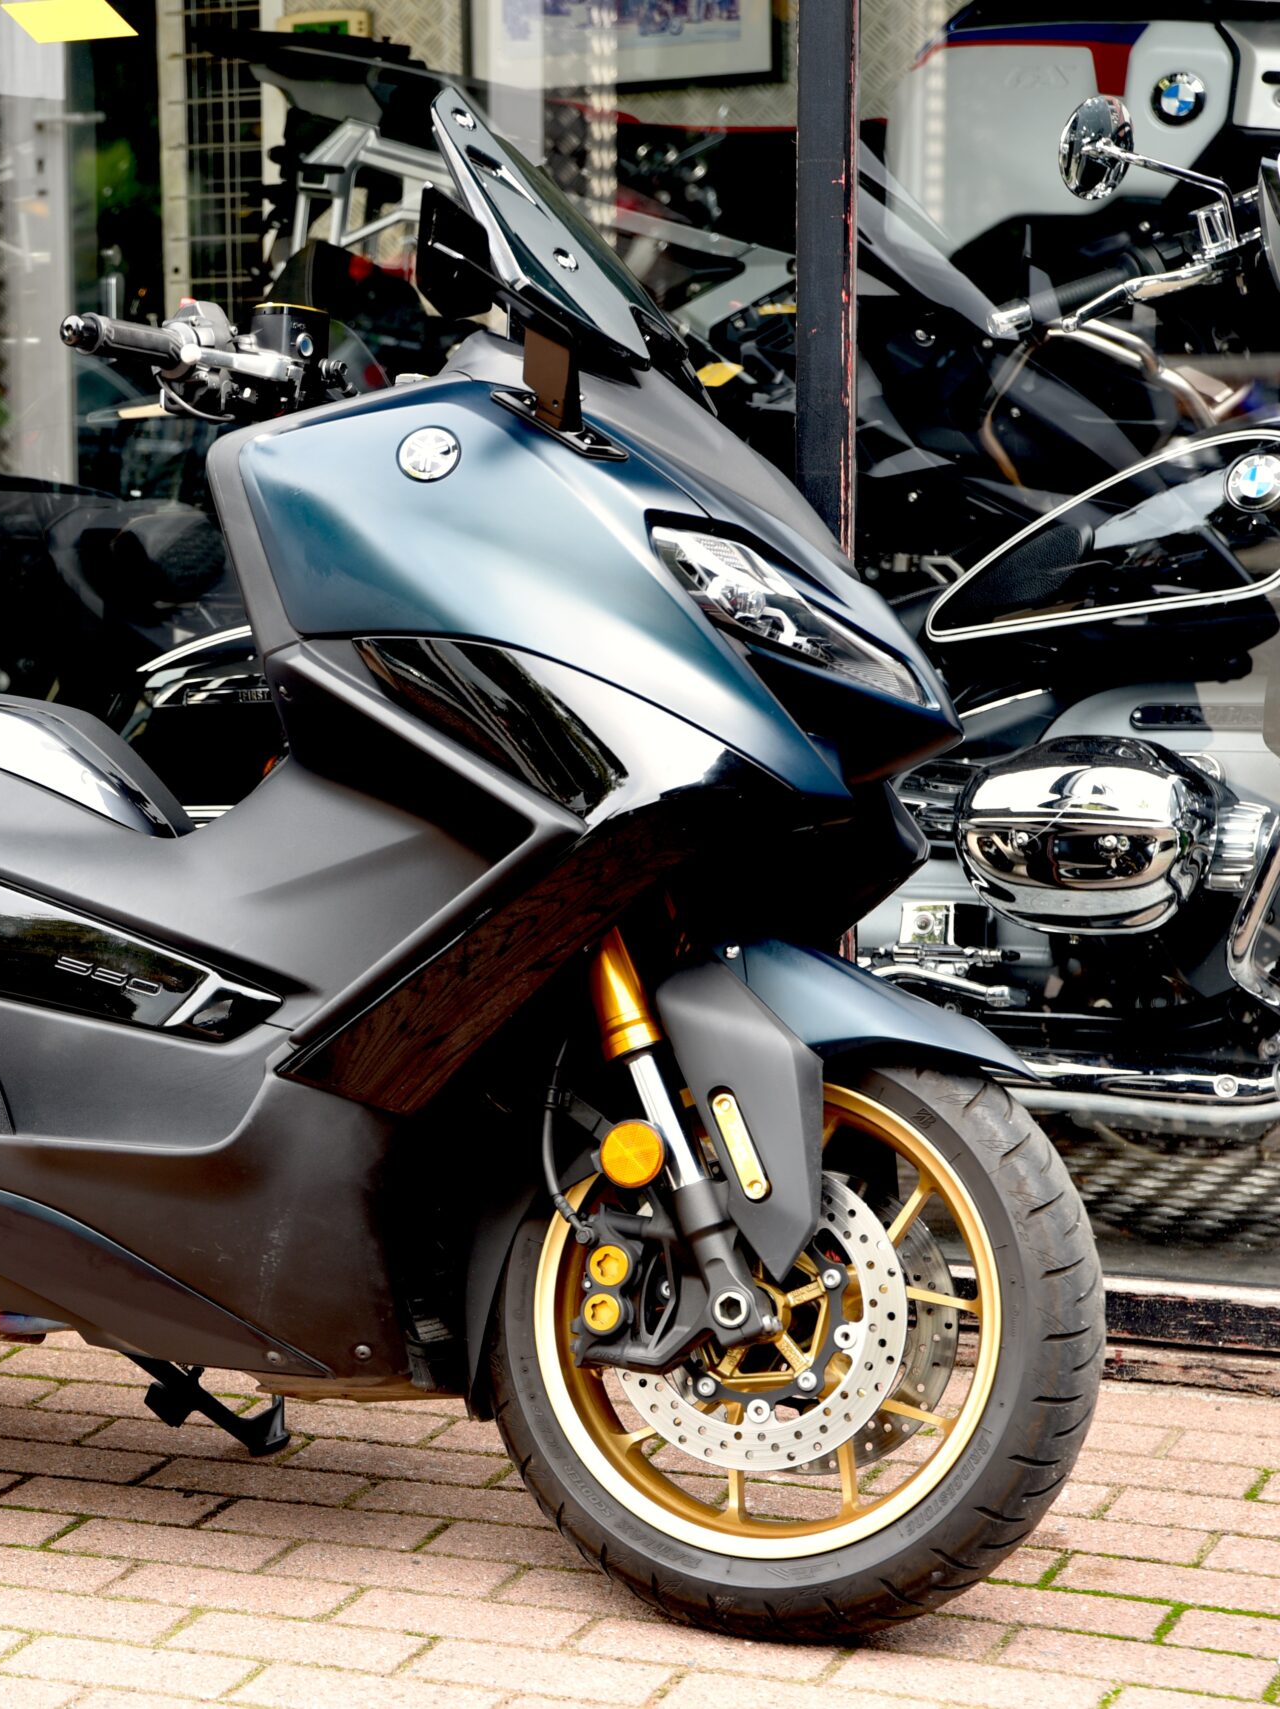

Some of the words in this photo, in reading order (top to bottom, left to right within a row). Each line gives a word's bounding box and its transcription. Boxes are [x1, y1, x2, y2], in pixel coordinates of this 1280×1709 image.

[54, 955, 163, 997] 560
[563, 1464, 616, 1518] SCOOTER
[904, 1434, 991, 1537] BRIDGESTONE
[614, 1519, 704, 1570] BATTLAX
